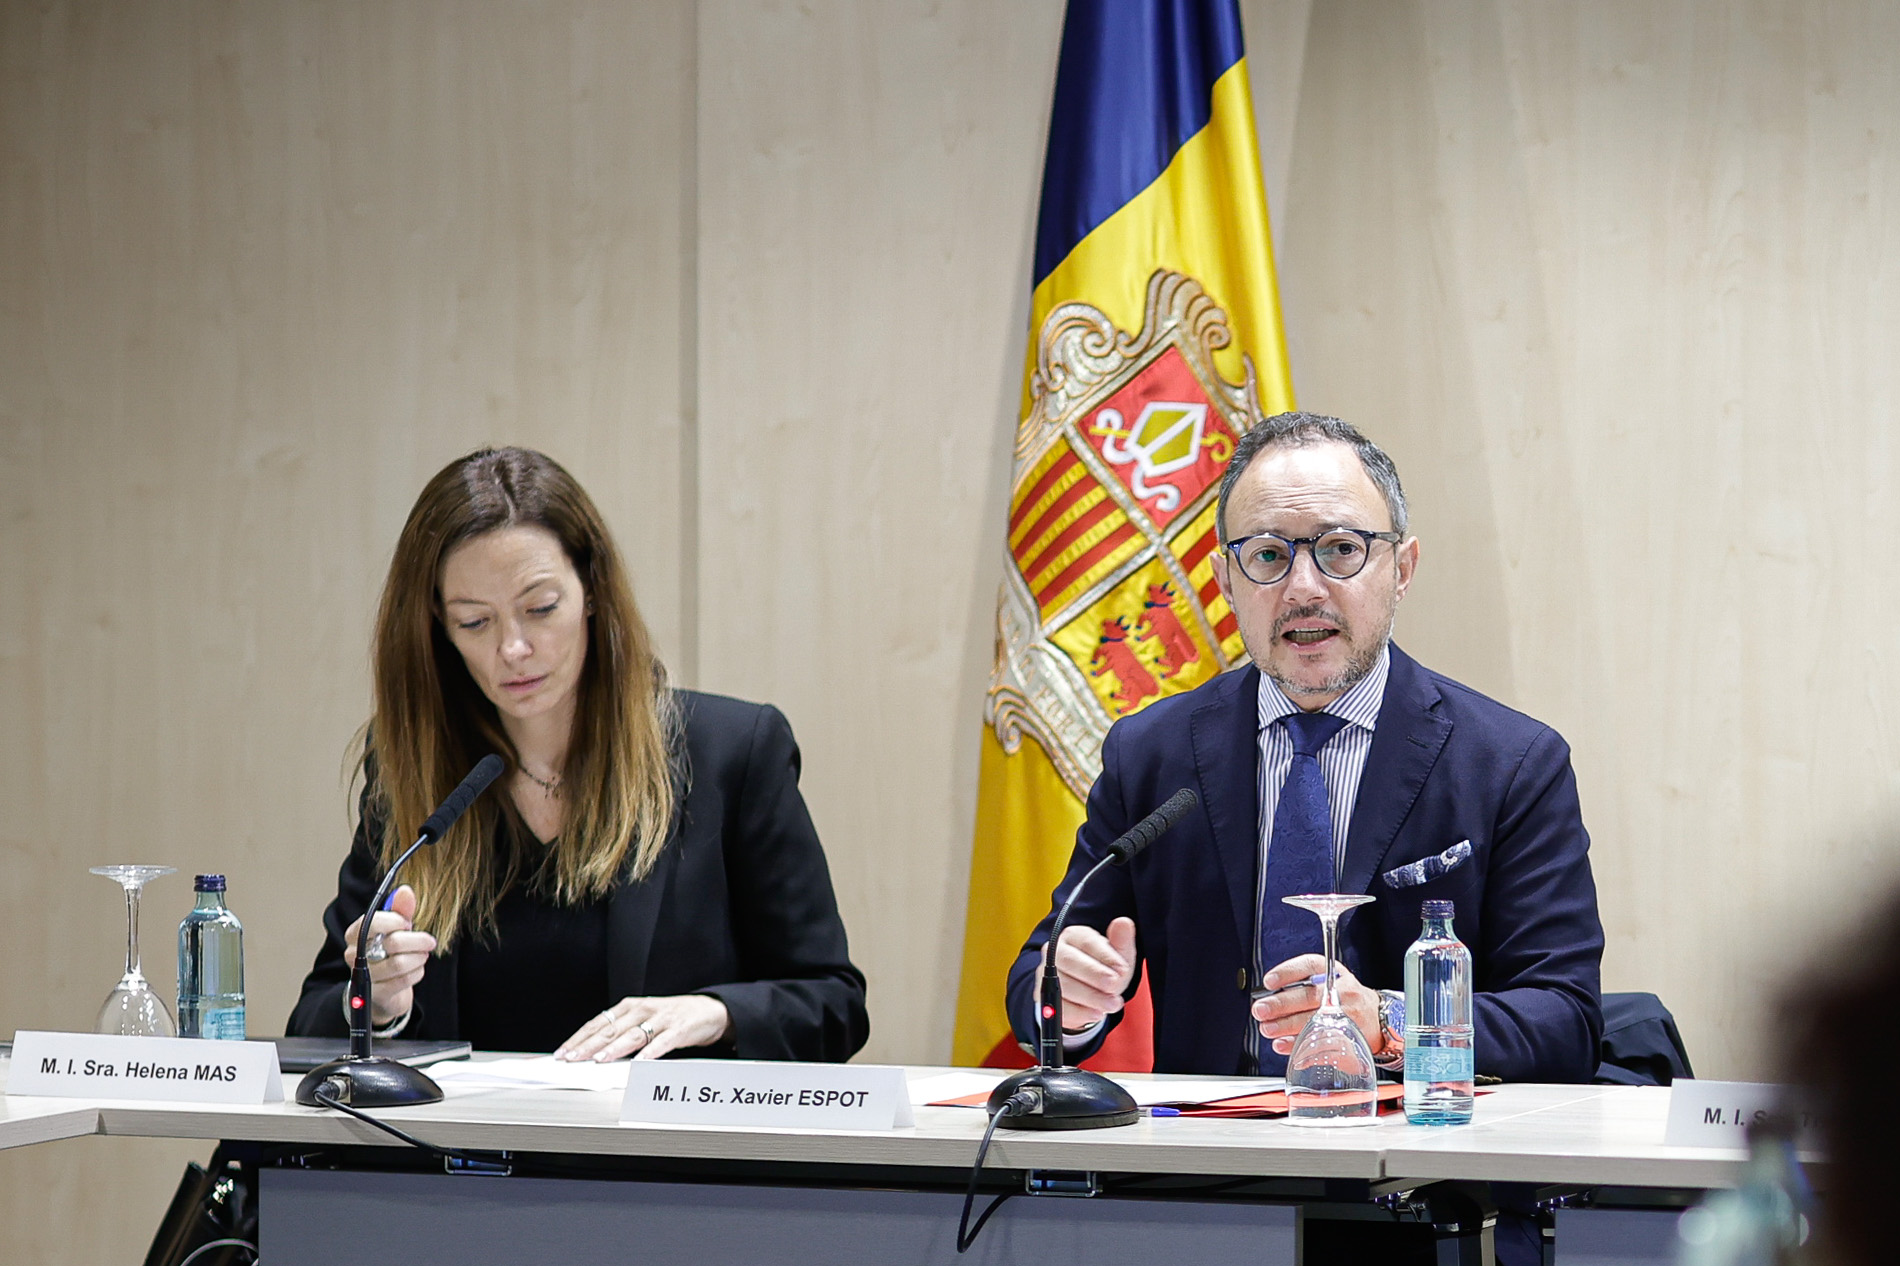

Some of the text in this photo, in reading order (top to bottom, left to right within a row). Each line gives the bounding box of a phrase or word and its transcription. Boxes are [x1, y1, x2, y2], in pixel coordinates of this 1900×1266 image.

[40, 1057, 237, 1082] M. I. Sra. Helena MAS
[652, 1085, 869, 1108] M. I. Sr. Xavier ESPOT
[1704, 1107, 1726, 1124] M.
[1734, 1109, 1745, 1126] I.
